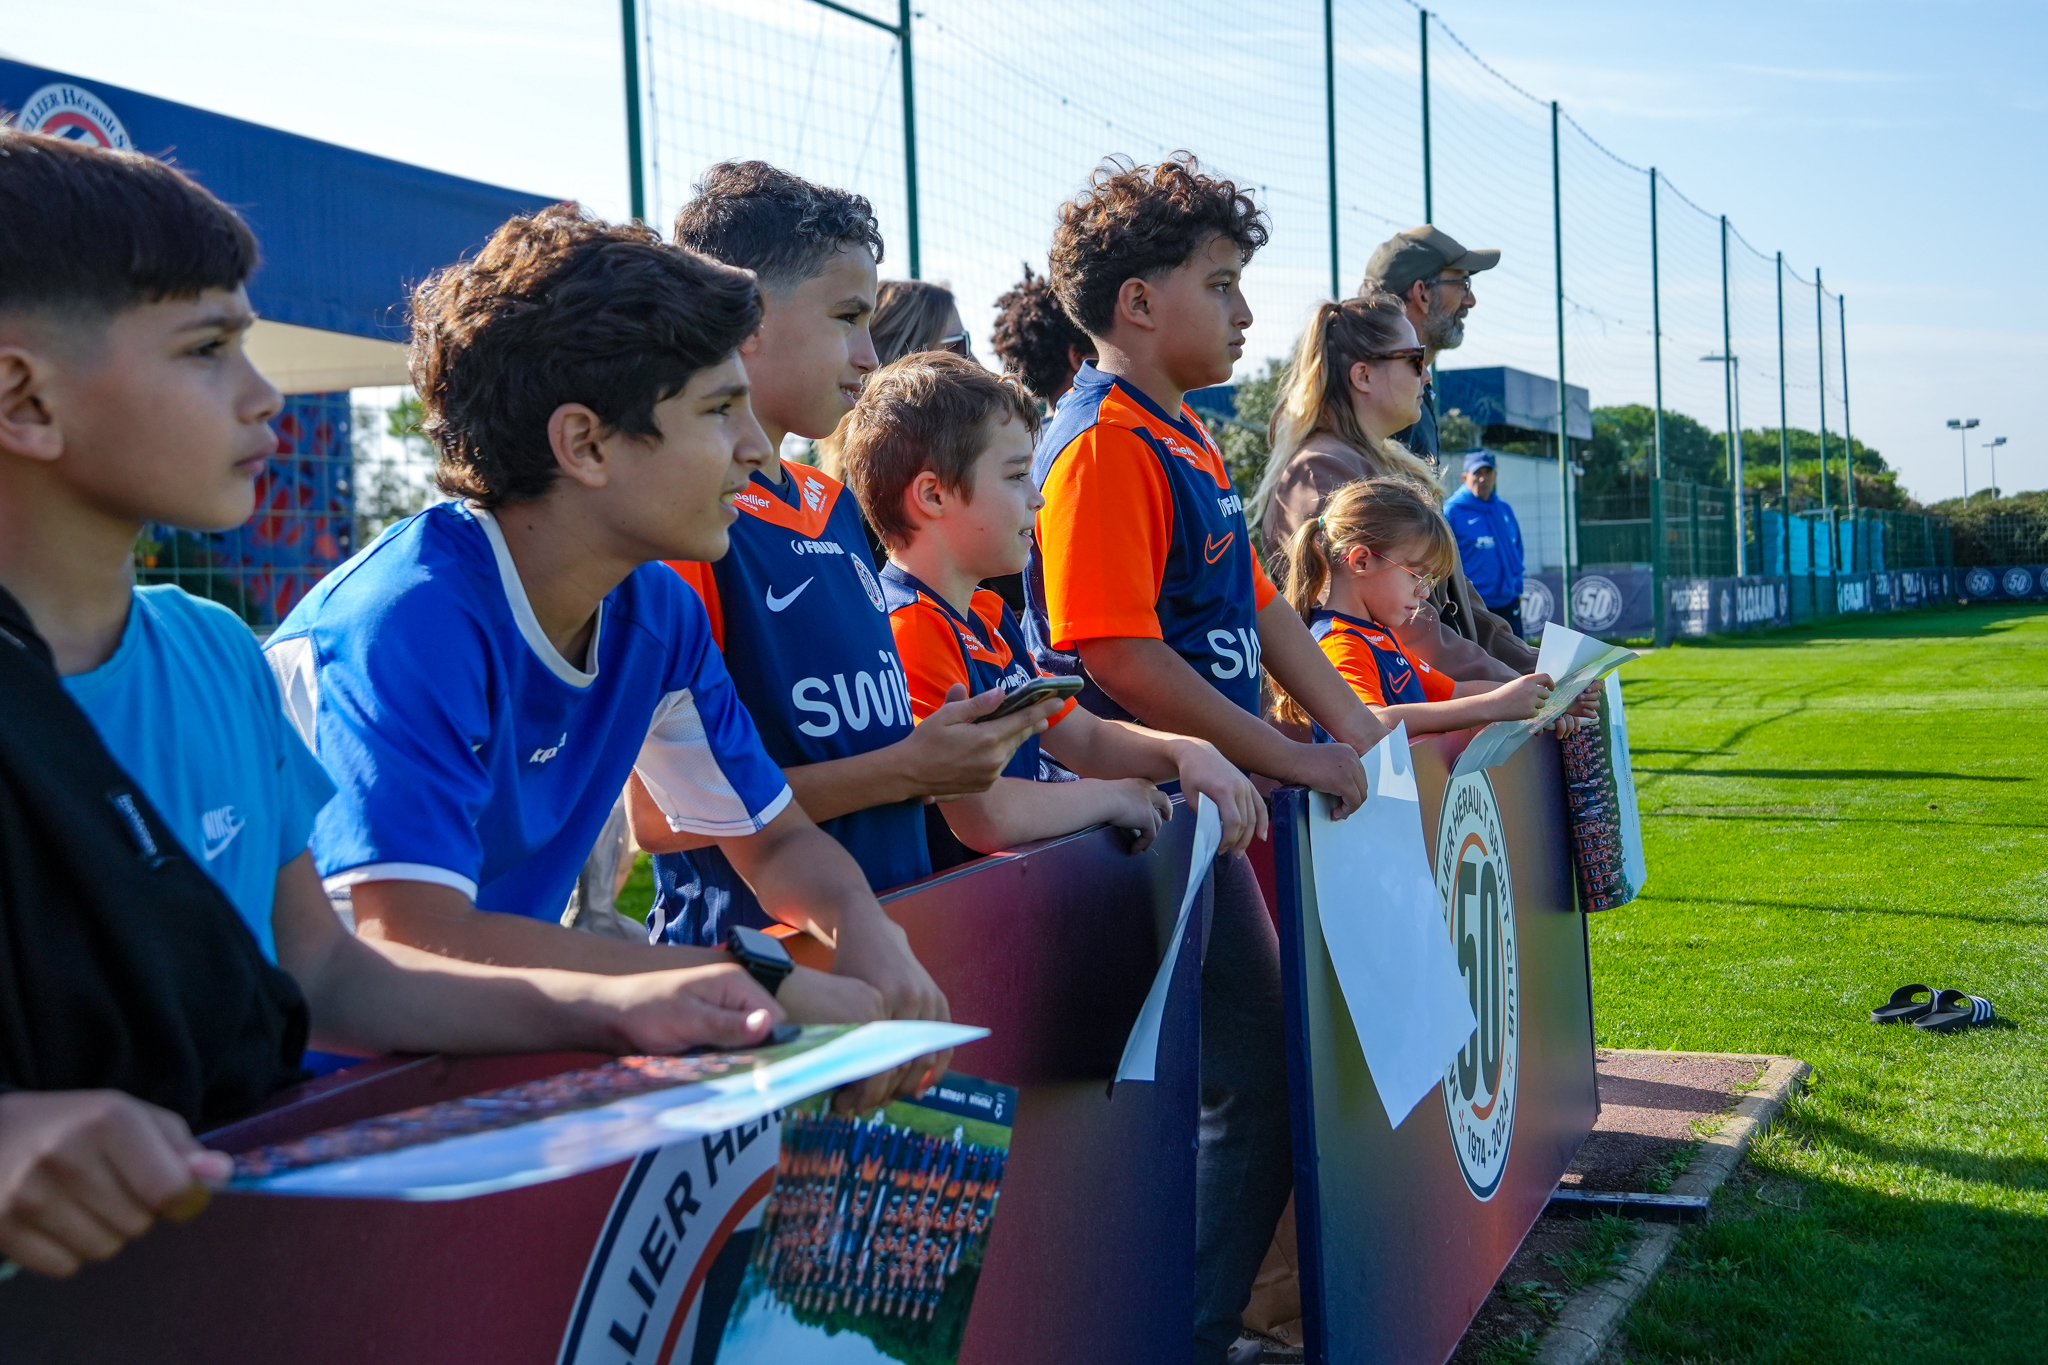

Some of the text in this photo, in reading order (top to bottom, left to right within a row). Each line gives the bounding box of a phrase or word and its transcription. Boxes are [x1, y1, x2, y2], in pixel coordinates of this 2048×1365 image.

[803, 541, 844, 555] FAUN
[1579, 587, 1611, 620] 50
[1452, 785, 1488, 836] HÉRAULT
[1489, 819, 1510, 924] SPORT
[1506, 938, 1515, 1039] CLUB
[1457, 860, 1500, 1101] 50
[608, 1170, 702, 1365] LIER
